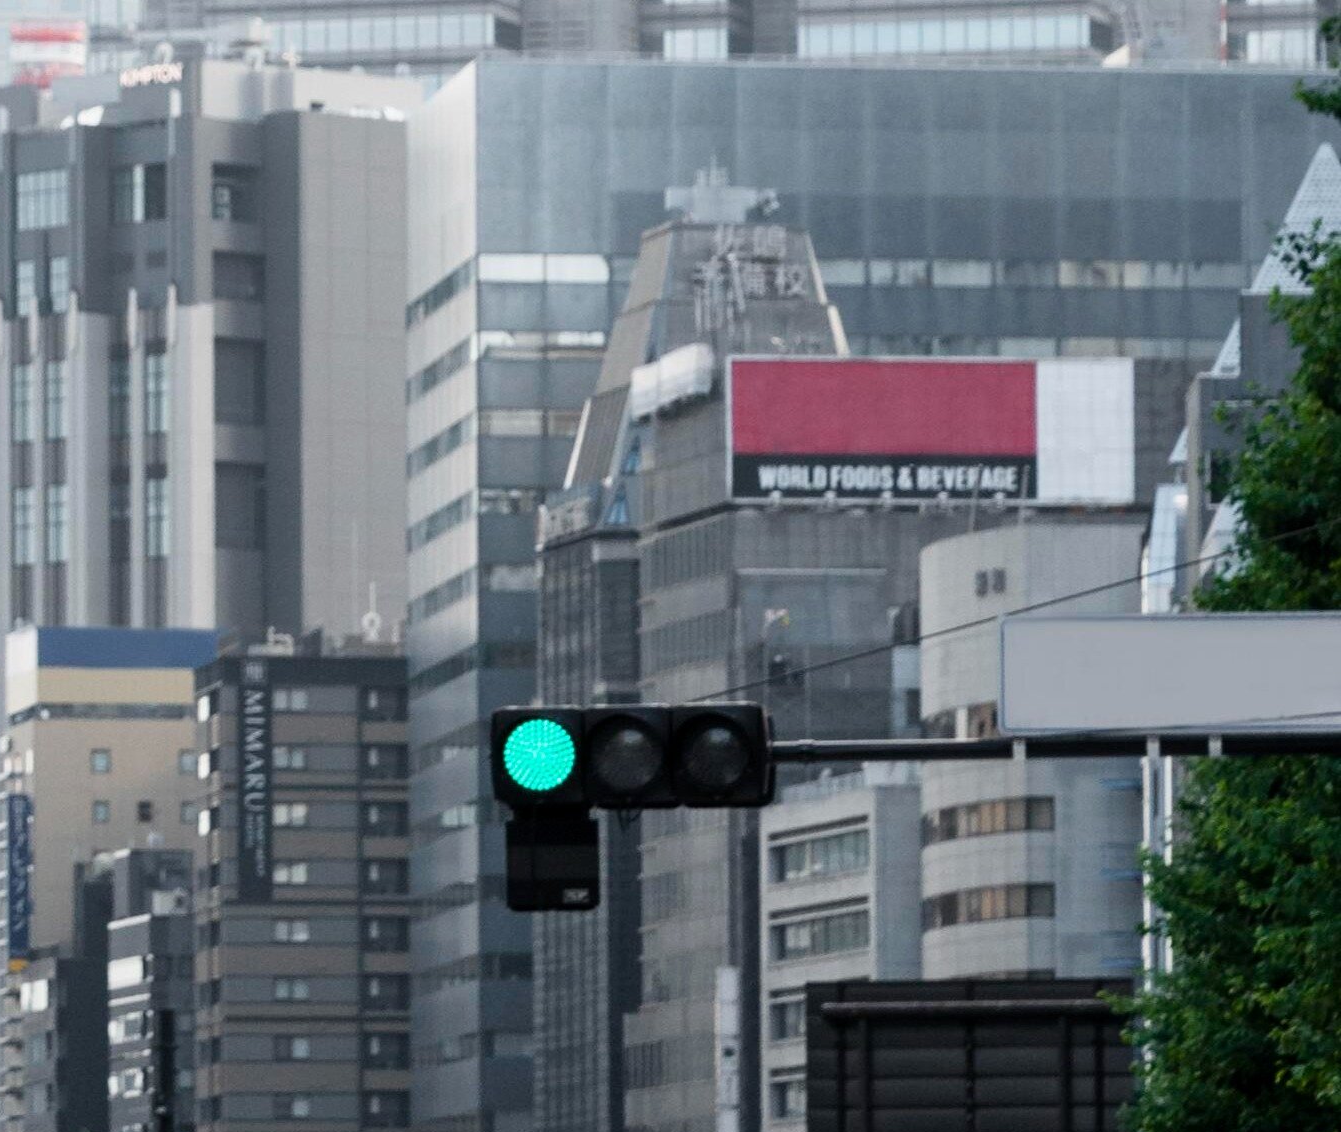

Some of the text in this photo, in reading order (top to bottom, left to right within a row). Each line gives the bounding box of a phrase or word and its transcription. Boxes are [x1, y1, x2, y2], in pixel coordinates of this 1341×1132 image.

[758, 464, 1018, 491] WORLD FOODS & BEVERAGE
[244, 689, 266, 812] MIMARU
